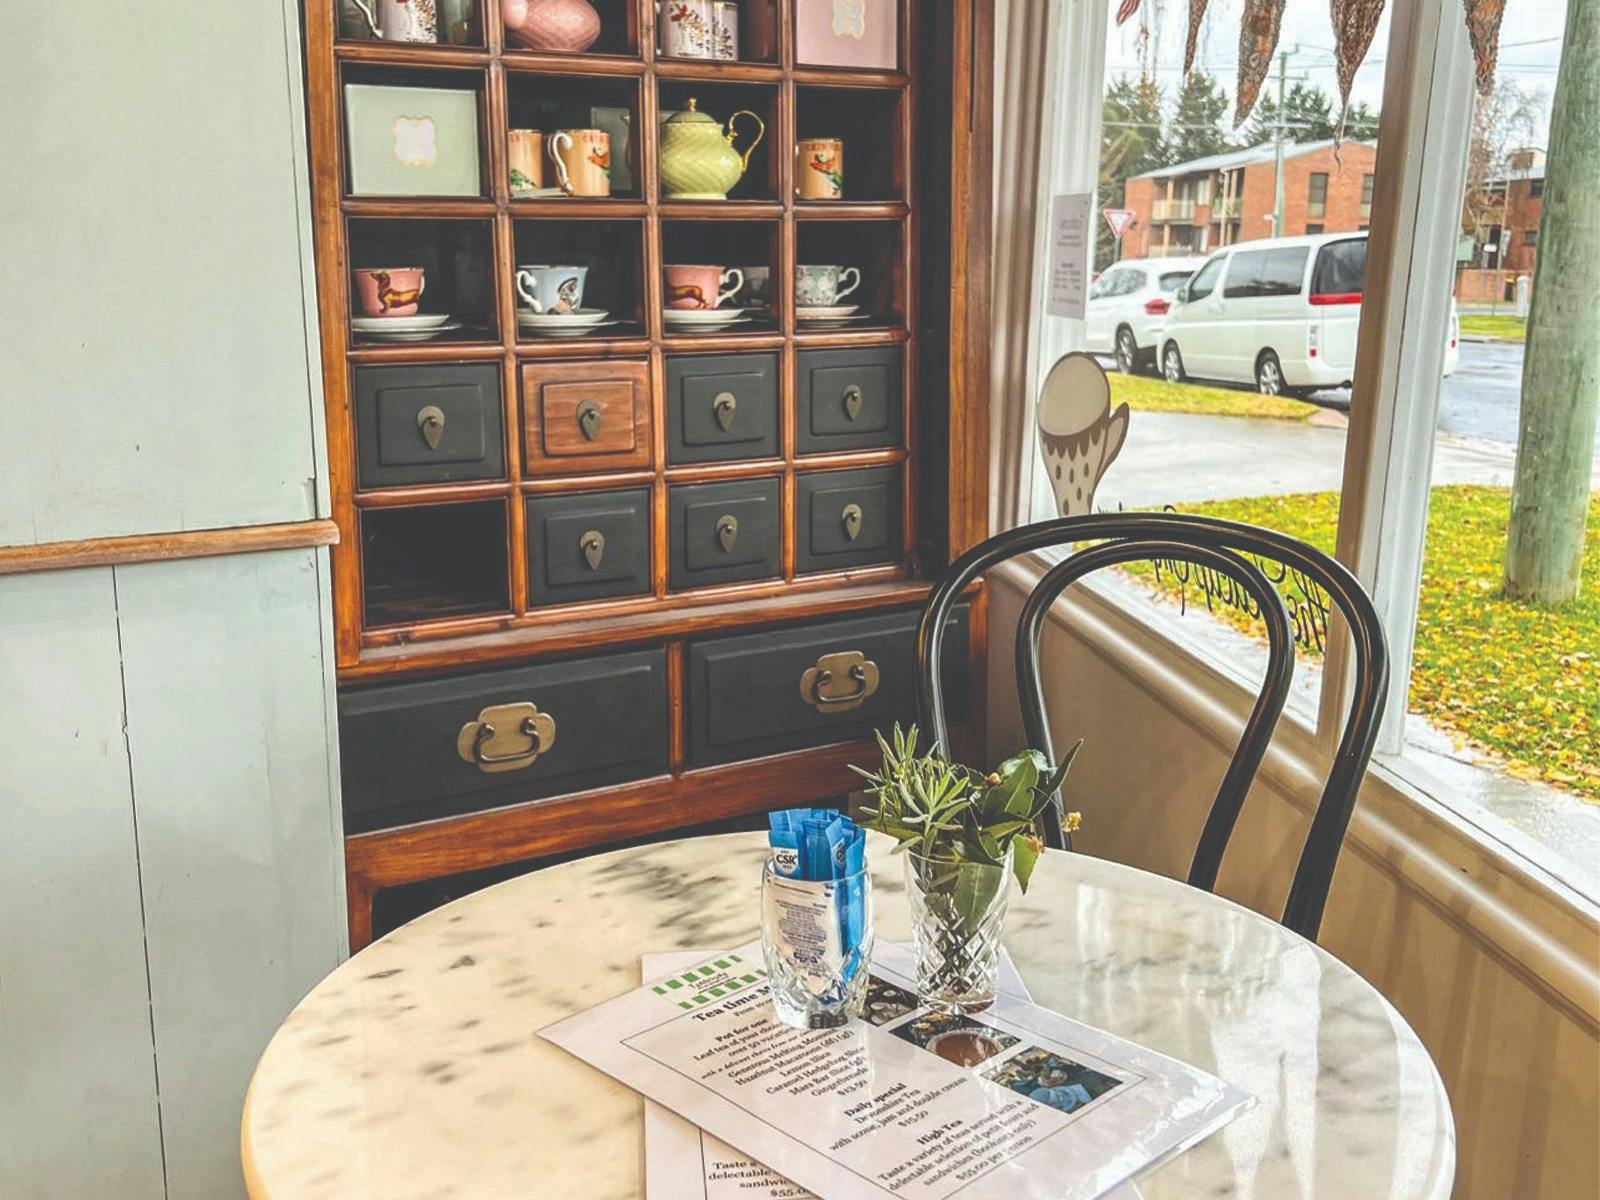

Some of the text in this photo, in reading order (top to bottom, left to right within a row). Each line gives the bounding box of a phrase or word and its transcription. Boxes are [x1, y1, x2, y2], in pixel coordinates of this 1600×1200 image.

[776, 854, 796, 865] CSR
[691, 1008, 726, 1022] Tea
[722, 993, 759, 1011] time
[732, 1026, 750, 1036] for
[768, 1044, 806, 1061] Melting
[734, 1065, 778, 1086] Hazelnut
[765, 1074, 805, 1095] Caramel
[843, 1082, 907, 1118] Daily special
[853, 1089, 921, 1125] Devonshire Tea
[829, 1138, 853, 1151] with
[876, 1114, 898, 1127] jam
[895, 1103, 915, 1117] and
[916, 1120, 963, 1146] High Tea
[877, 1164, 907, 1182] Taste
[911, 1143, 945, 1163] variety
[995, 1103, 1017, 1116] with
[889, 1162, 936, 1191] delectable
[934, 1141, 974, 1165] selection
[1022, 1102, 1040, 1116] and
[713, 1161, 747, 1170] Taste
[923, 1155, 975, 1187] sandwiches
